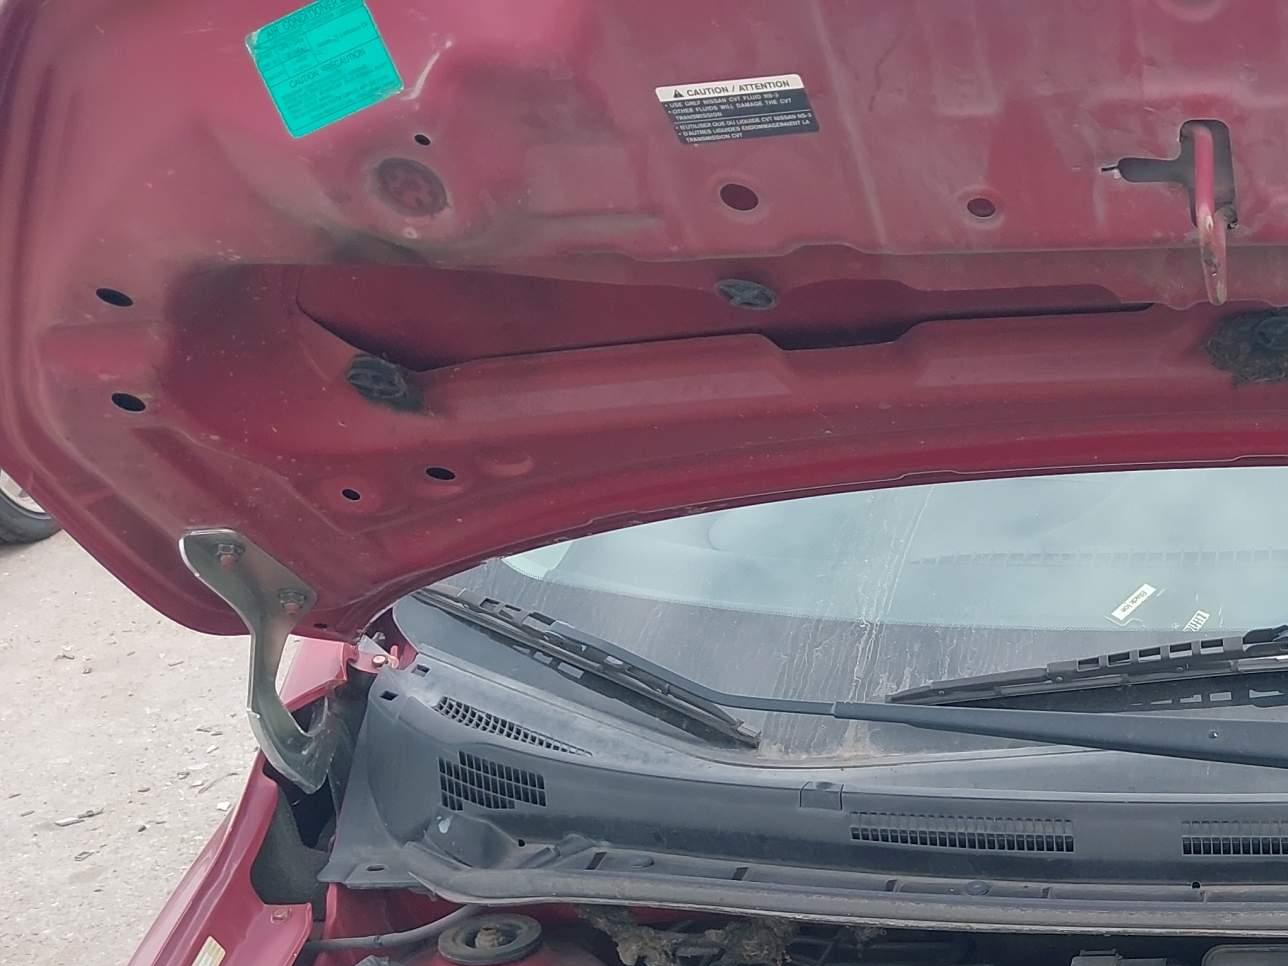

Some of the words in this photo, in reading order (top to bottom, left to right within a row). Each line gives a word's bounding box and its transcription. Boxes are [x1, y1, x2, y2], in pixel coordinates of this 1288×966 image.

[686, 86, 729, 97] CAUTION
[738, 80, 790, 92] ATTENTION
[703, 96, 727, 104] NISSAN
[672, 106, 694, 114] OTHER
[696, 104, 718, 112] FLUIDS
[736, 101, 763, 109] DAMAGE
[676, 112, 722, 121] TRANSMISSION
[774, 114, 796, 122] NISSAN
